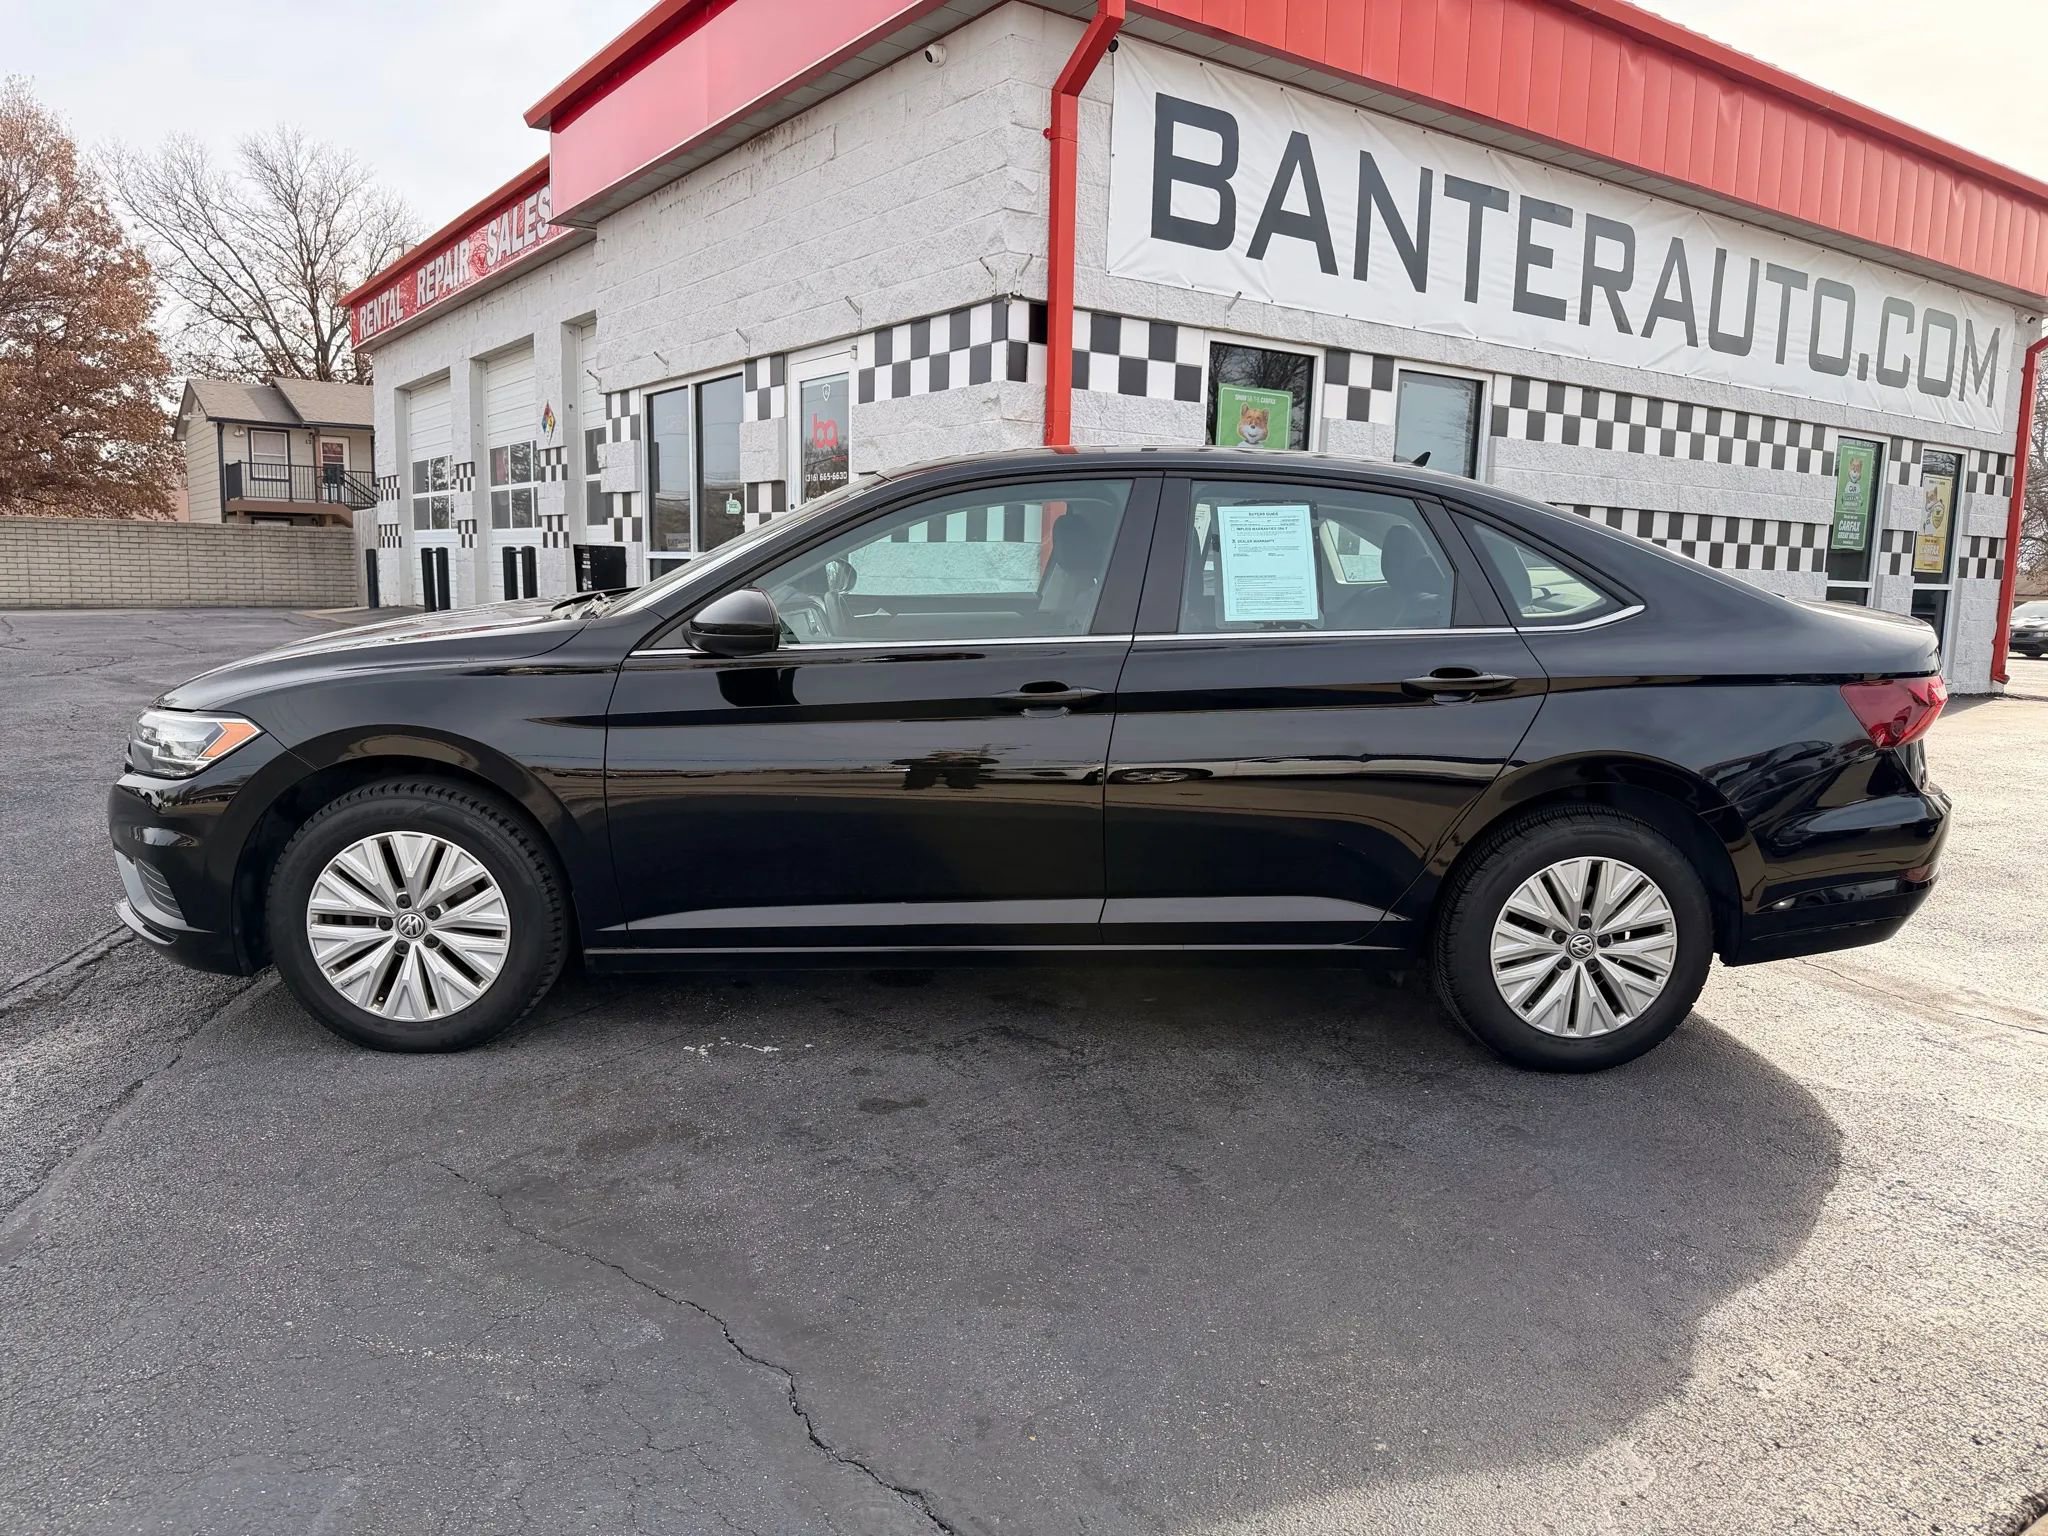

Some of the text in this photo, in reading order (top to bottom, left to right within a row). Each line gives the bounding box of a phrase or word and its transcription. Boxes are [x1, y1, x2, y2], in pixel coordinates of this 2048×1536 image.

[359, 184, 550, 340] RENTAL REPAIR SALES
[1151, 92, 2001, 408] BANTERAUTO.COM
[819, 471, 848, 481] 665-6630
[1838, 519, 1861, 532] CARFAX
